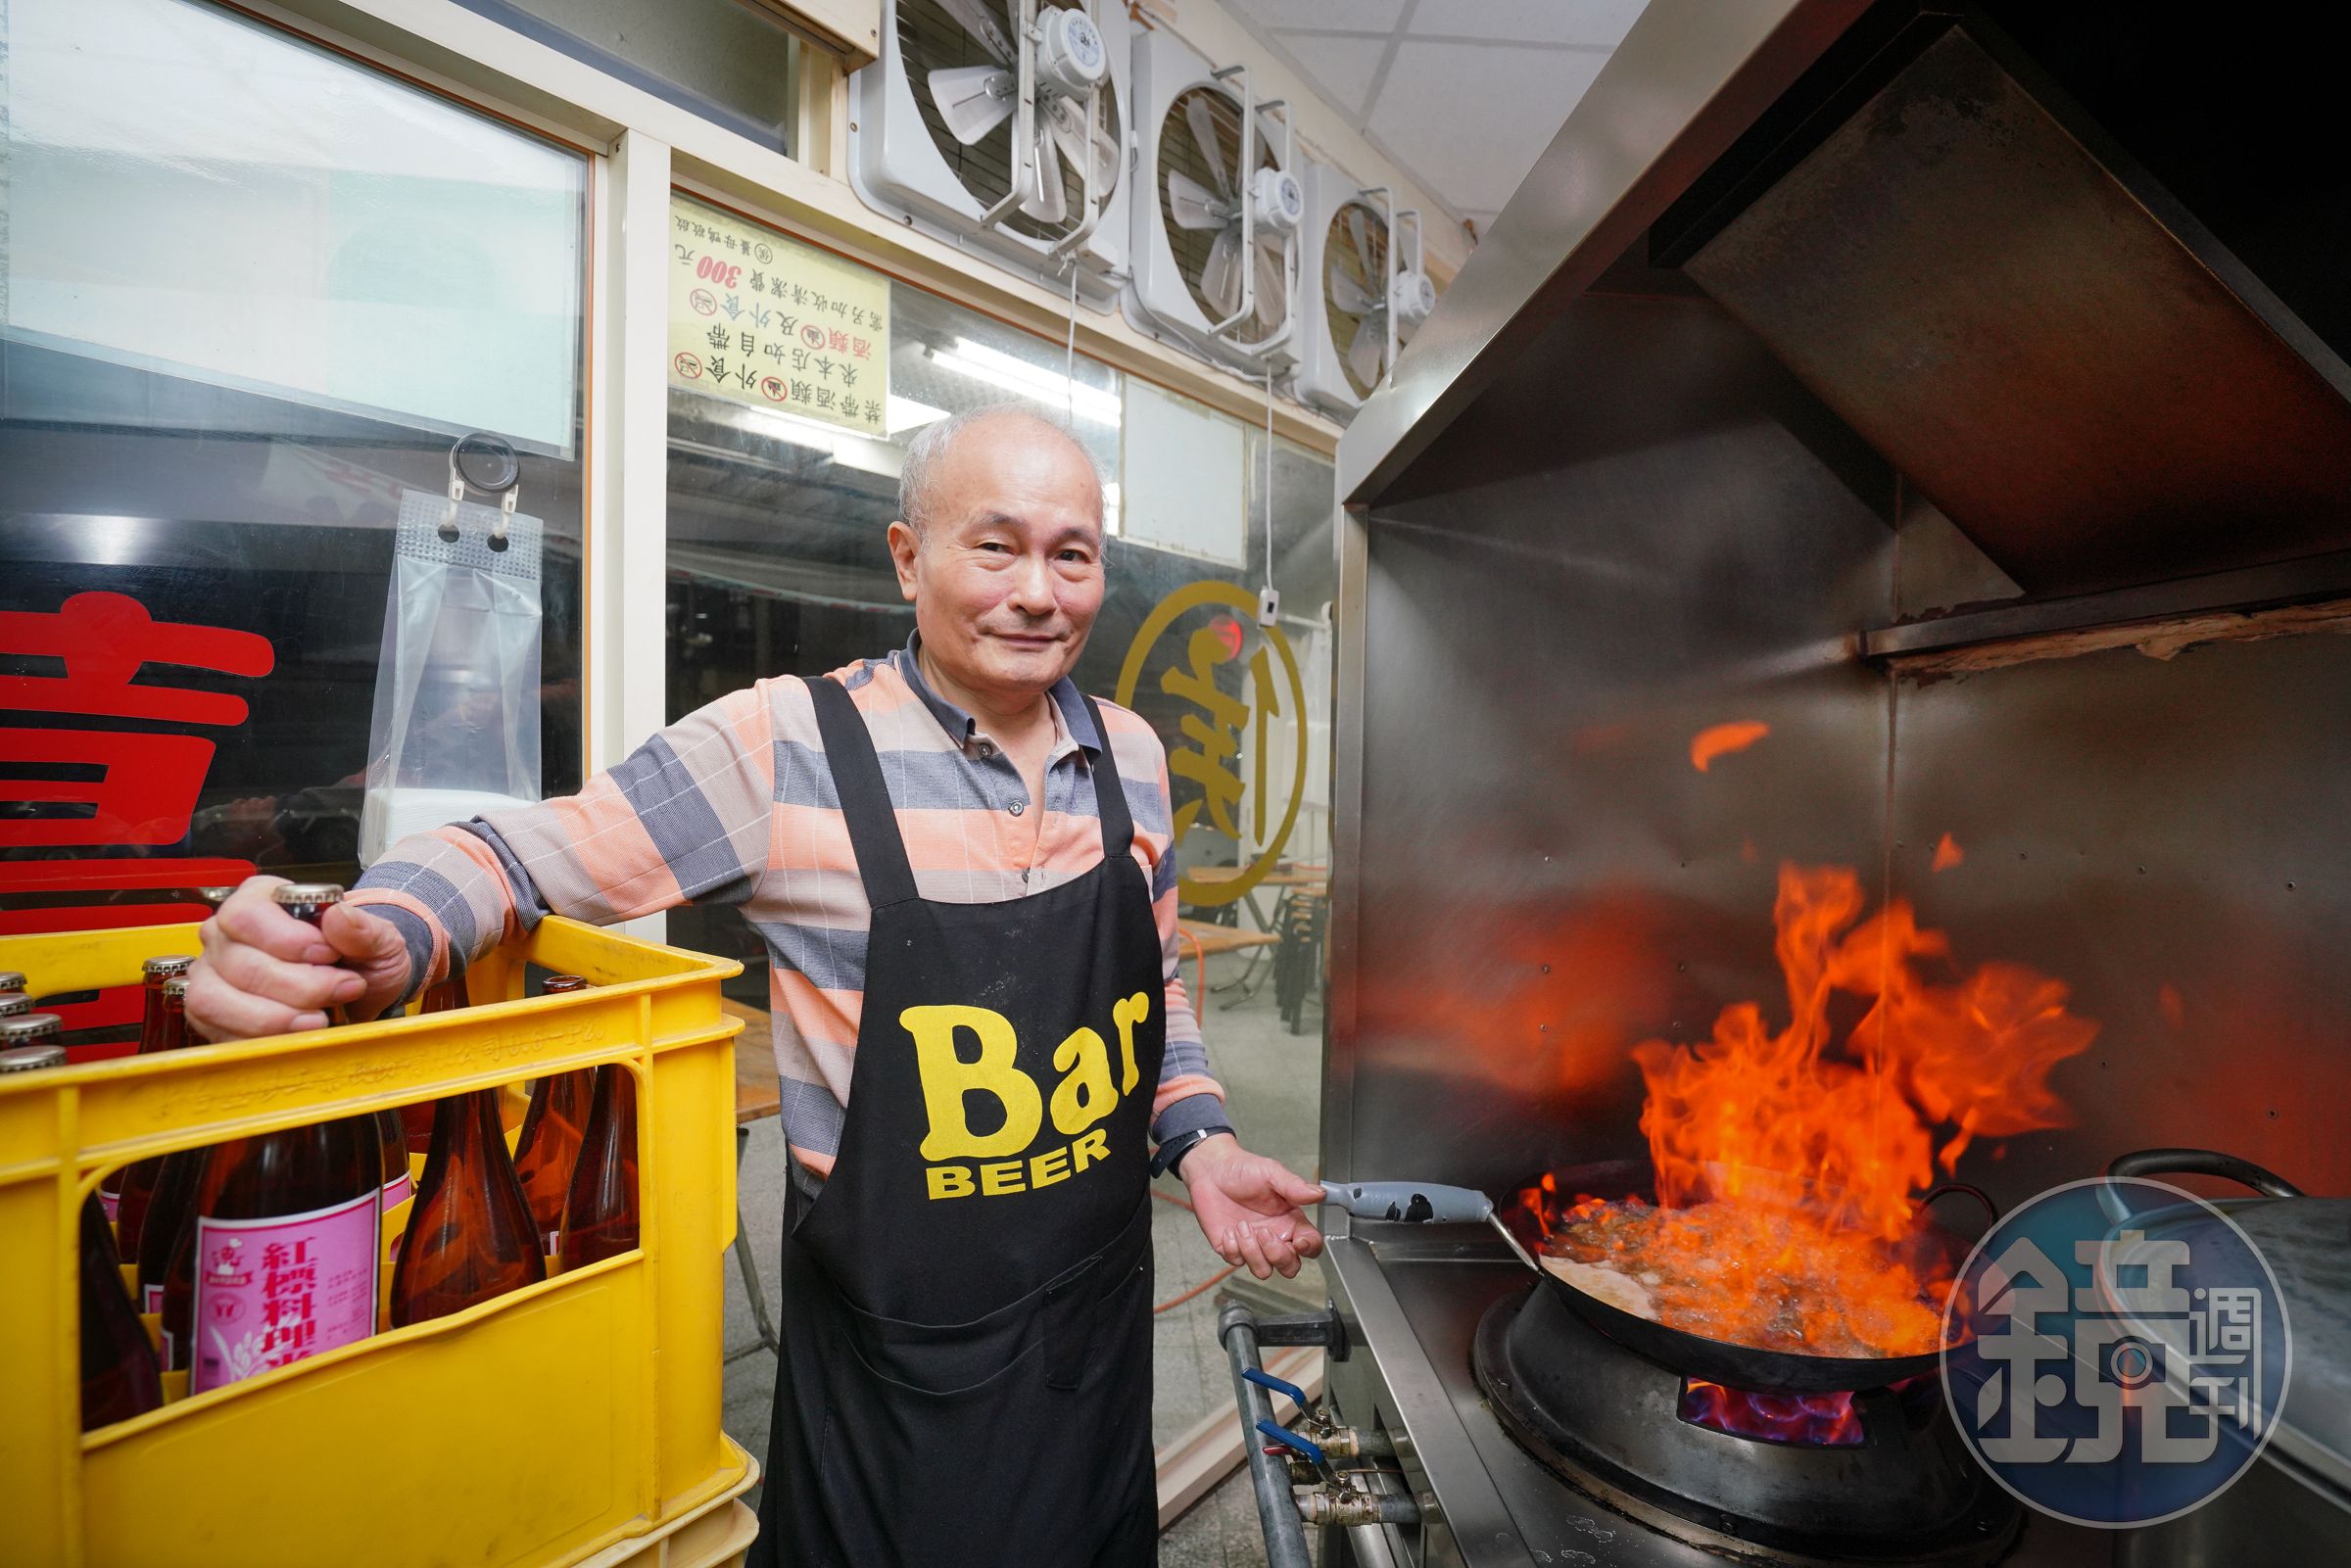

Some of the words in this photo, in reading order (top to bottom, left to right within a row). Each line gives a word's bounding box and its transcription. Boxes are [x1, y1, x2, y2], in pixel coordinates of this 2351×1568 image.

[720, 292, 798, 337] 及外食
[706, 322, 858, 388] 來本店如自帶
[828, 327, 872, 361] 酒類
[705, 355, 758, 390] 外食
[791, 378, 882, 425] 禁帶酒類
[899, 991, 1149, 1162] Bar
[926, 1128, 1111, 1201] BEER
